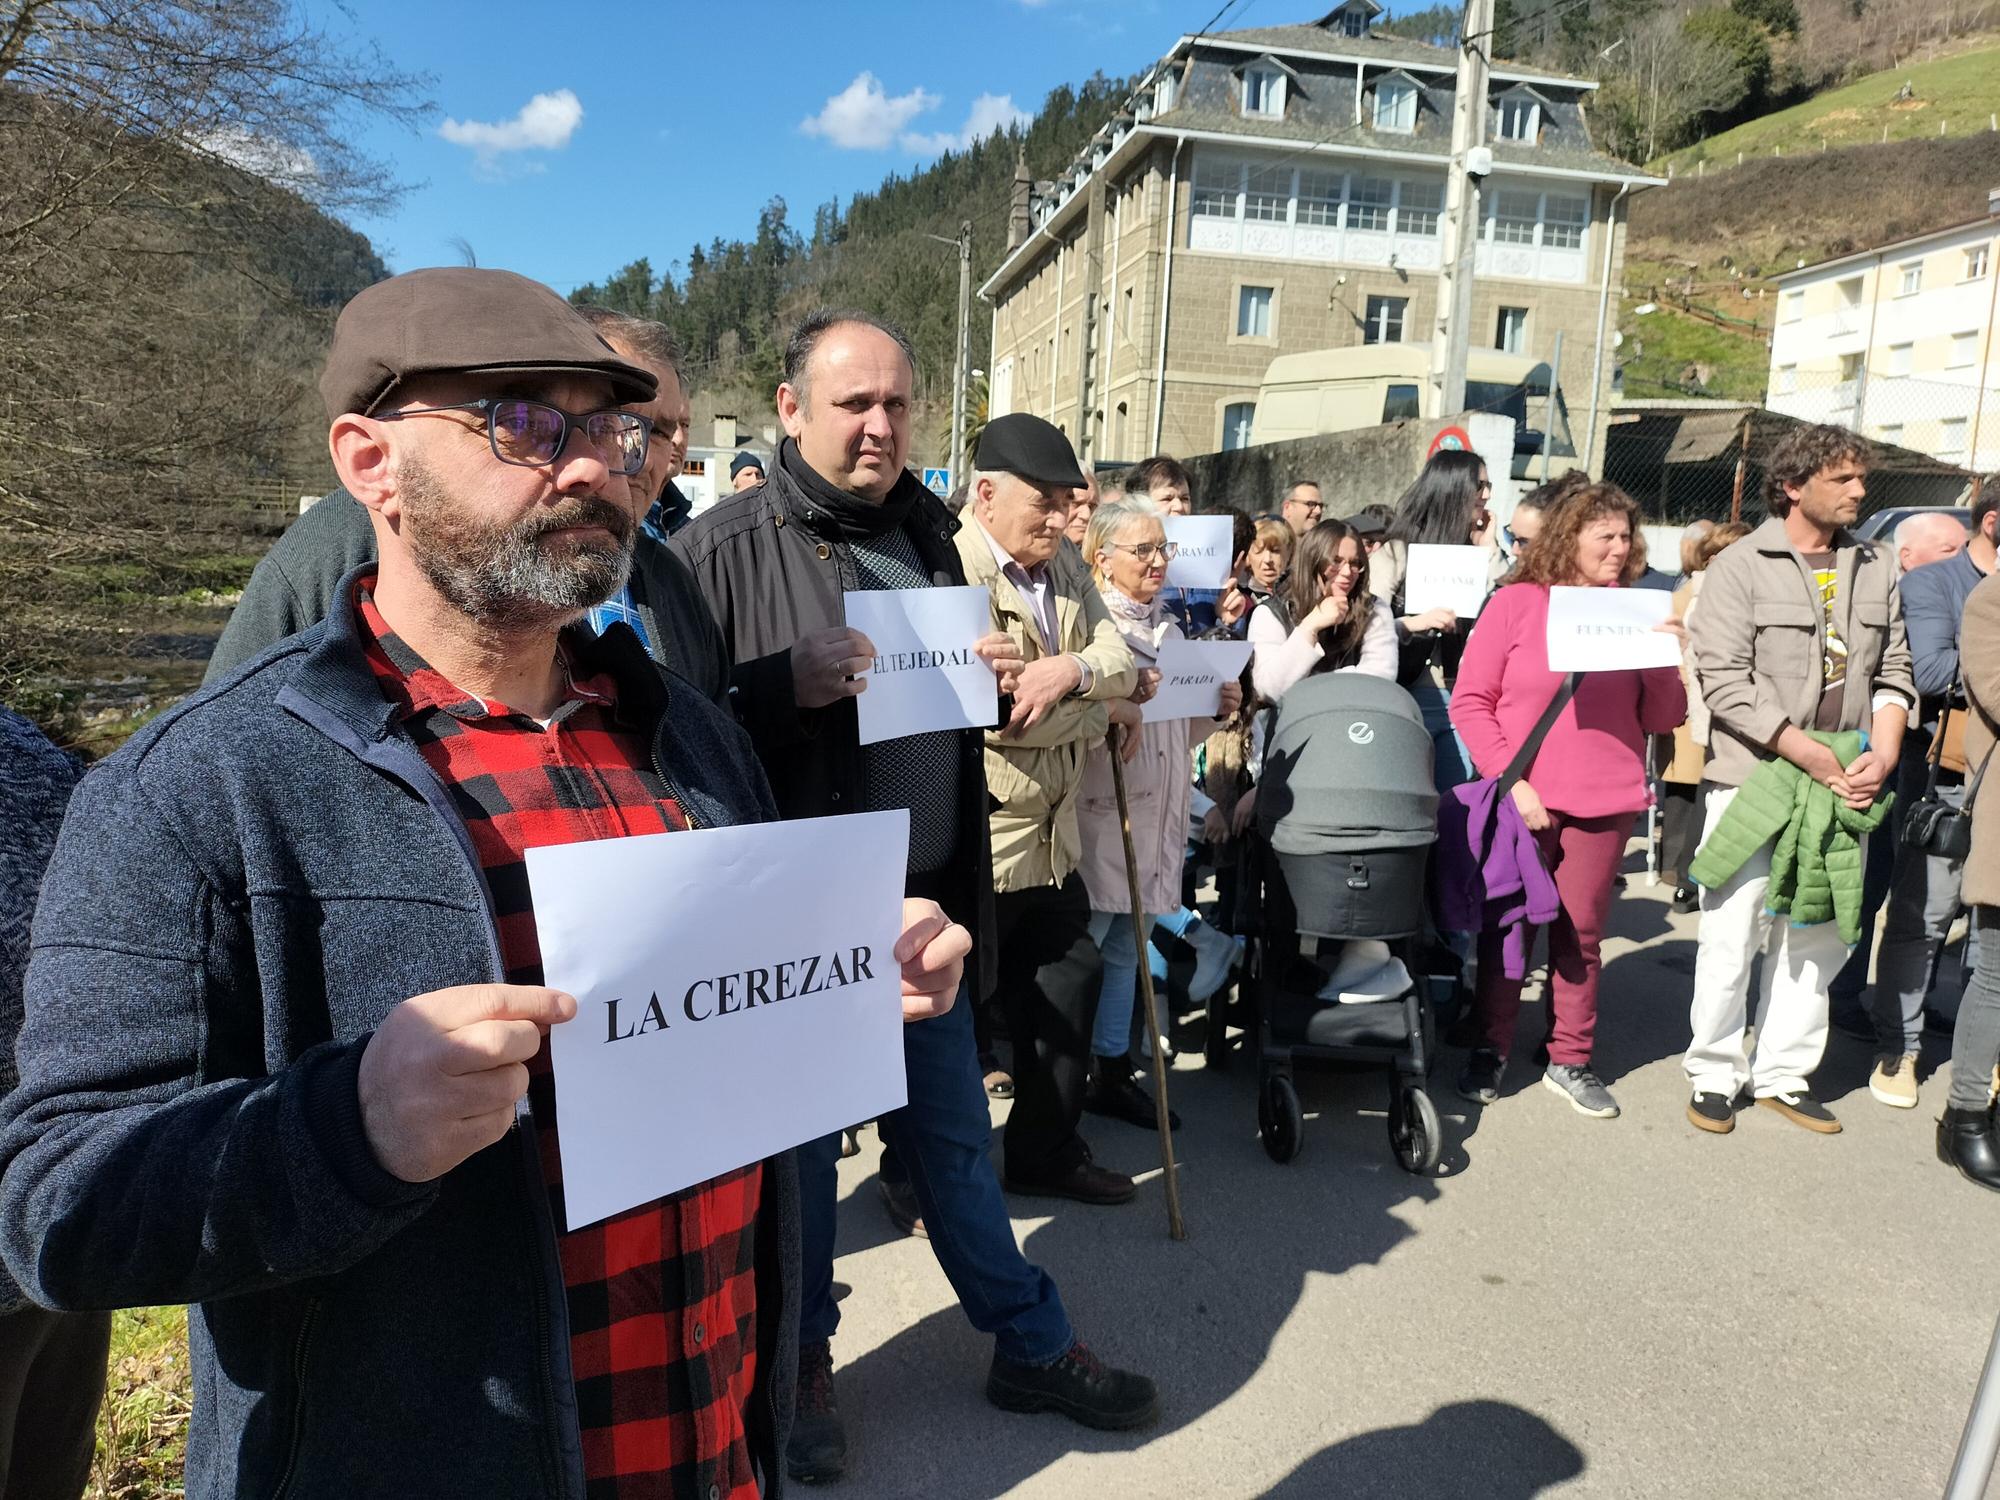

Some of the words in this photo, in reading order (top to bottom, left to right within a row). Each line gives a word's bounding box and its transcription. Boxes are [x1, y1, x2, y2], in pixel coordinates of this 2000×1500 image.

[873, 655, 887, 675] EL
[891, 648, 976, 672] TEJEDAL
[1169, 674, 1215, 687] PARADA
[603, 990, 671, 1045] LA
[683, 945, 875, 1023] CEREZAR
